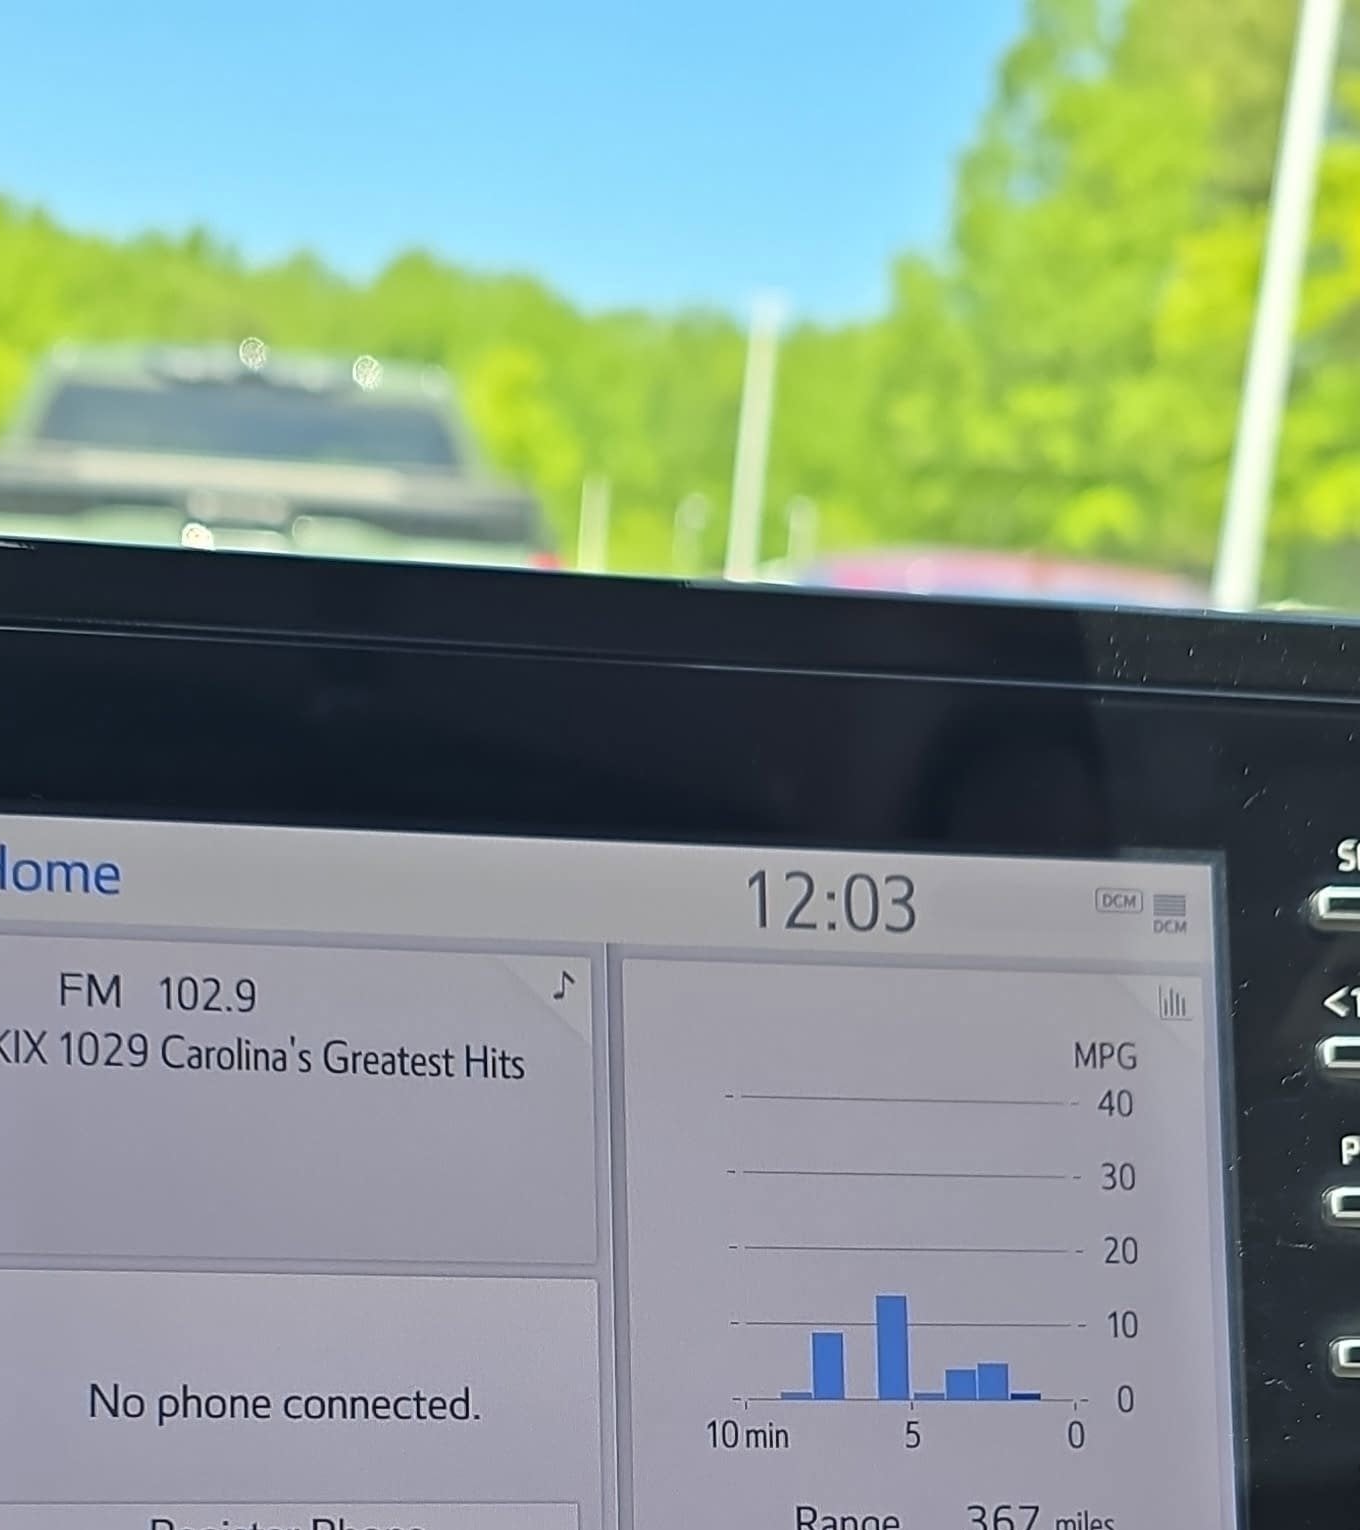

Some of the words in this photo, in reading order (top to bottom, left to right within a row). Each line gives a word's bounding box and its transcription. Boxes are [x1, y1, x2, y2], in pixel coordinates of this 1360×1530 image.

[747, 869, 918, 934] 12:03
[1102, 893, 1137, 909] DCM
[1153, 919, 1188, 934] DCM
[58, 972, 122, 1009] FM
[159, 976, 257, 1013] 102.9
[60, 1031, 149, 1068] 1029
[161, 1035, 313, 1074] Carolina's
[322, 1040, 456, 1079] Greatest
[464, 1045, 526, 1080] Hits
[1073, 1041, 1138, 1070] MPG
[1098, 1089, 1134, 1118] 40
[1101, 1163, 1137, 1192] 30
[1104, 1236, 1139, 1265] 20
[1108, 1311, 1138, 1339] 10
[89, 1383, 145, 1418] No
[157, 1384, 272, 1425] phone
[283, 1388, 482, 1421] connected.
[1117, 1385, 1136, 1413] 0
[707, 1419, 738, 1449] 10
[745, 1421, 789, 1449] min
[905, 1420, 921, 1448] 5
[1067, 1420, 1085, 1449] 0
